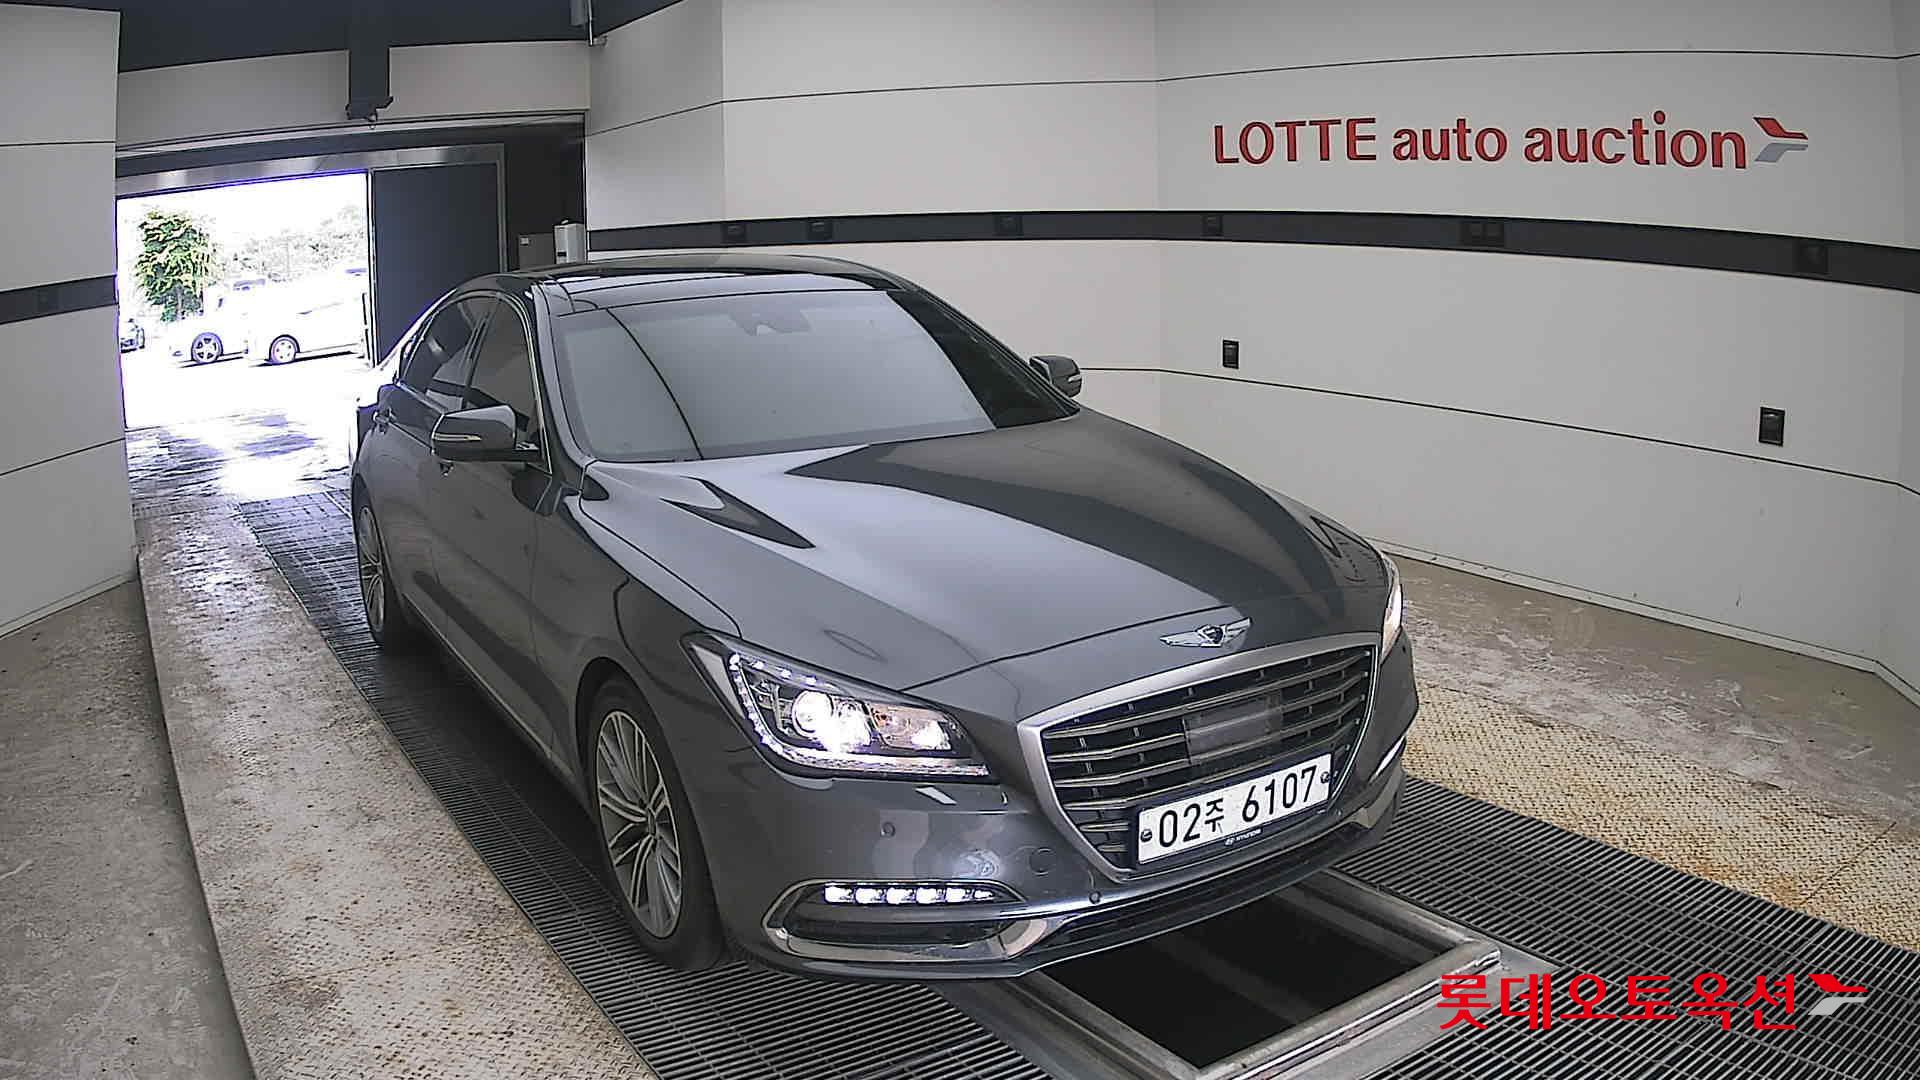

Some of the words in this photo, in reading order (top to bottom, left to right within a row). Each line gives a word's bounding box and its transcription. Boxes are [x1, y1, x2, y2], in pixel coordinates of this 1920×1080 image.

[1214, 116, 1377, 164] LOTTE
[1392, 117, 1509, 162] auto
[1523, 109, 1748, 169] auction
[1158, 798, 1225, 848] 02주
[1241, 766, 1317, 823] 6107
